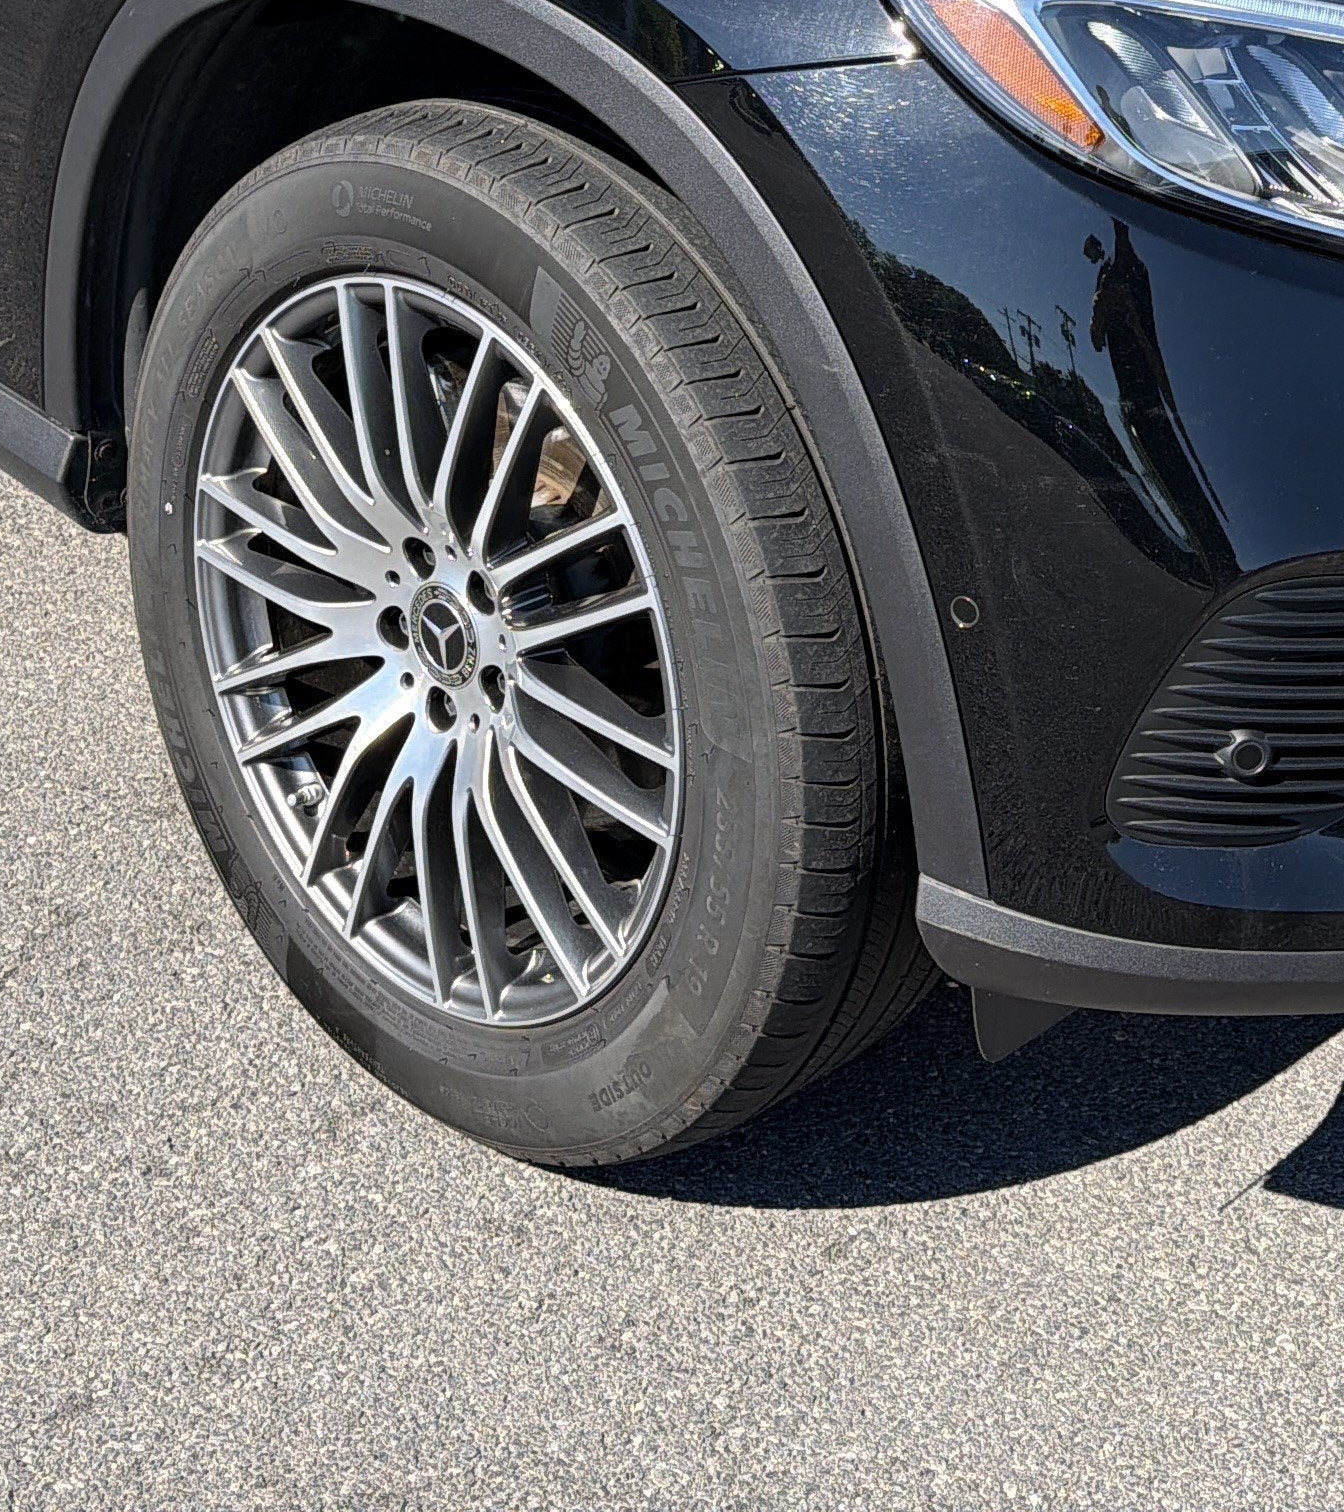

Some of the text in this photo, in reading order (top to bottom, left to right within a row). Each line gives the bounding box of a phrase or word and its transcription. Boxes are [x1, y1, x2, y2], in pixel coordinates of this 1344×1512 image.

[357, 202, 432, 232] Total Performance
[358, 186, 415, 209] MICHELIN
[611, 403, 741, 740] MICHELIN
[588, 1057, 653, 1113] OUTSIDE
